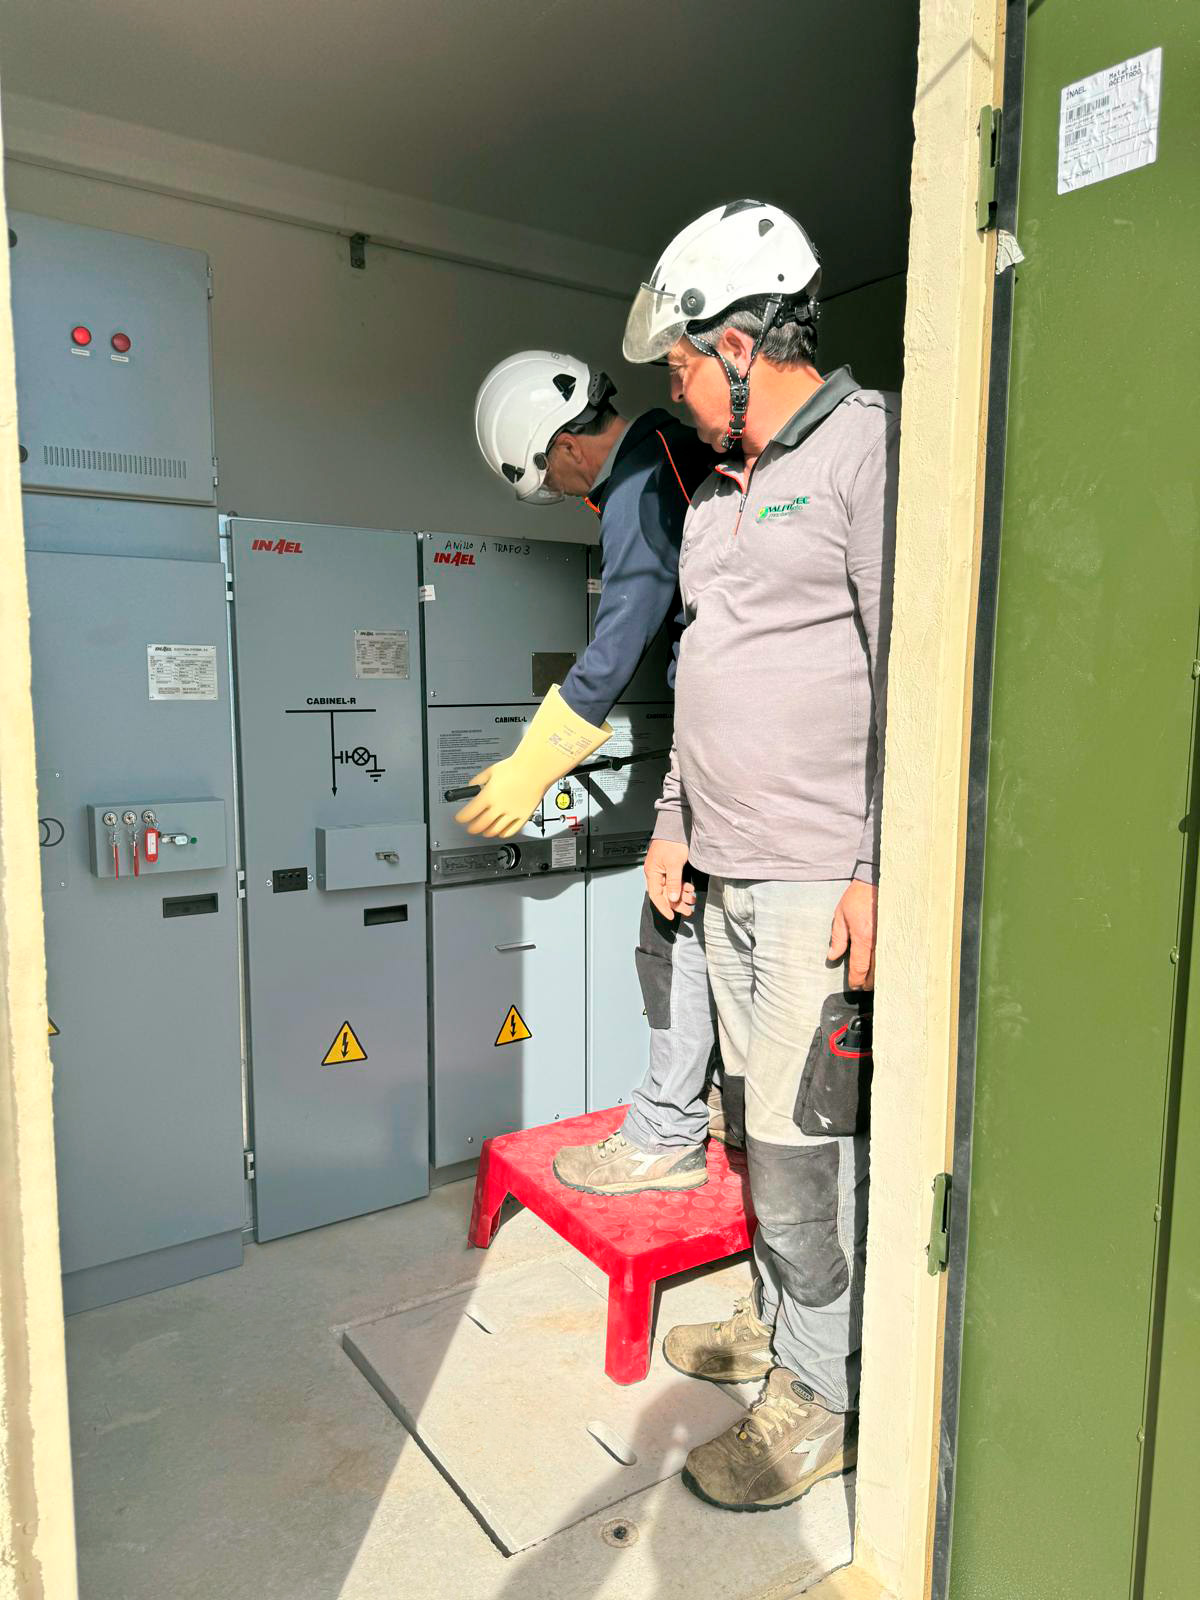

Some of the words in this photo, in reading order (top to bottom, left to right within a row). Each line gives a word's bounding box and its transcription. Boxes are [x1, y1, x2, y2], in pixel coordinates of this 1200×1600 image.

[252, 539, 303, 554] INAEL
[480, 542, 487, 553] A
[433, 551, 476, 566] INAEL
[306, 697, 357, 705] CABINEL-R
[494, 716, 528, 724] CABINEL-L
